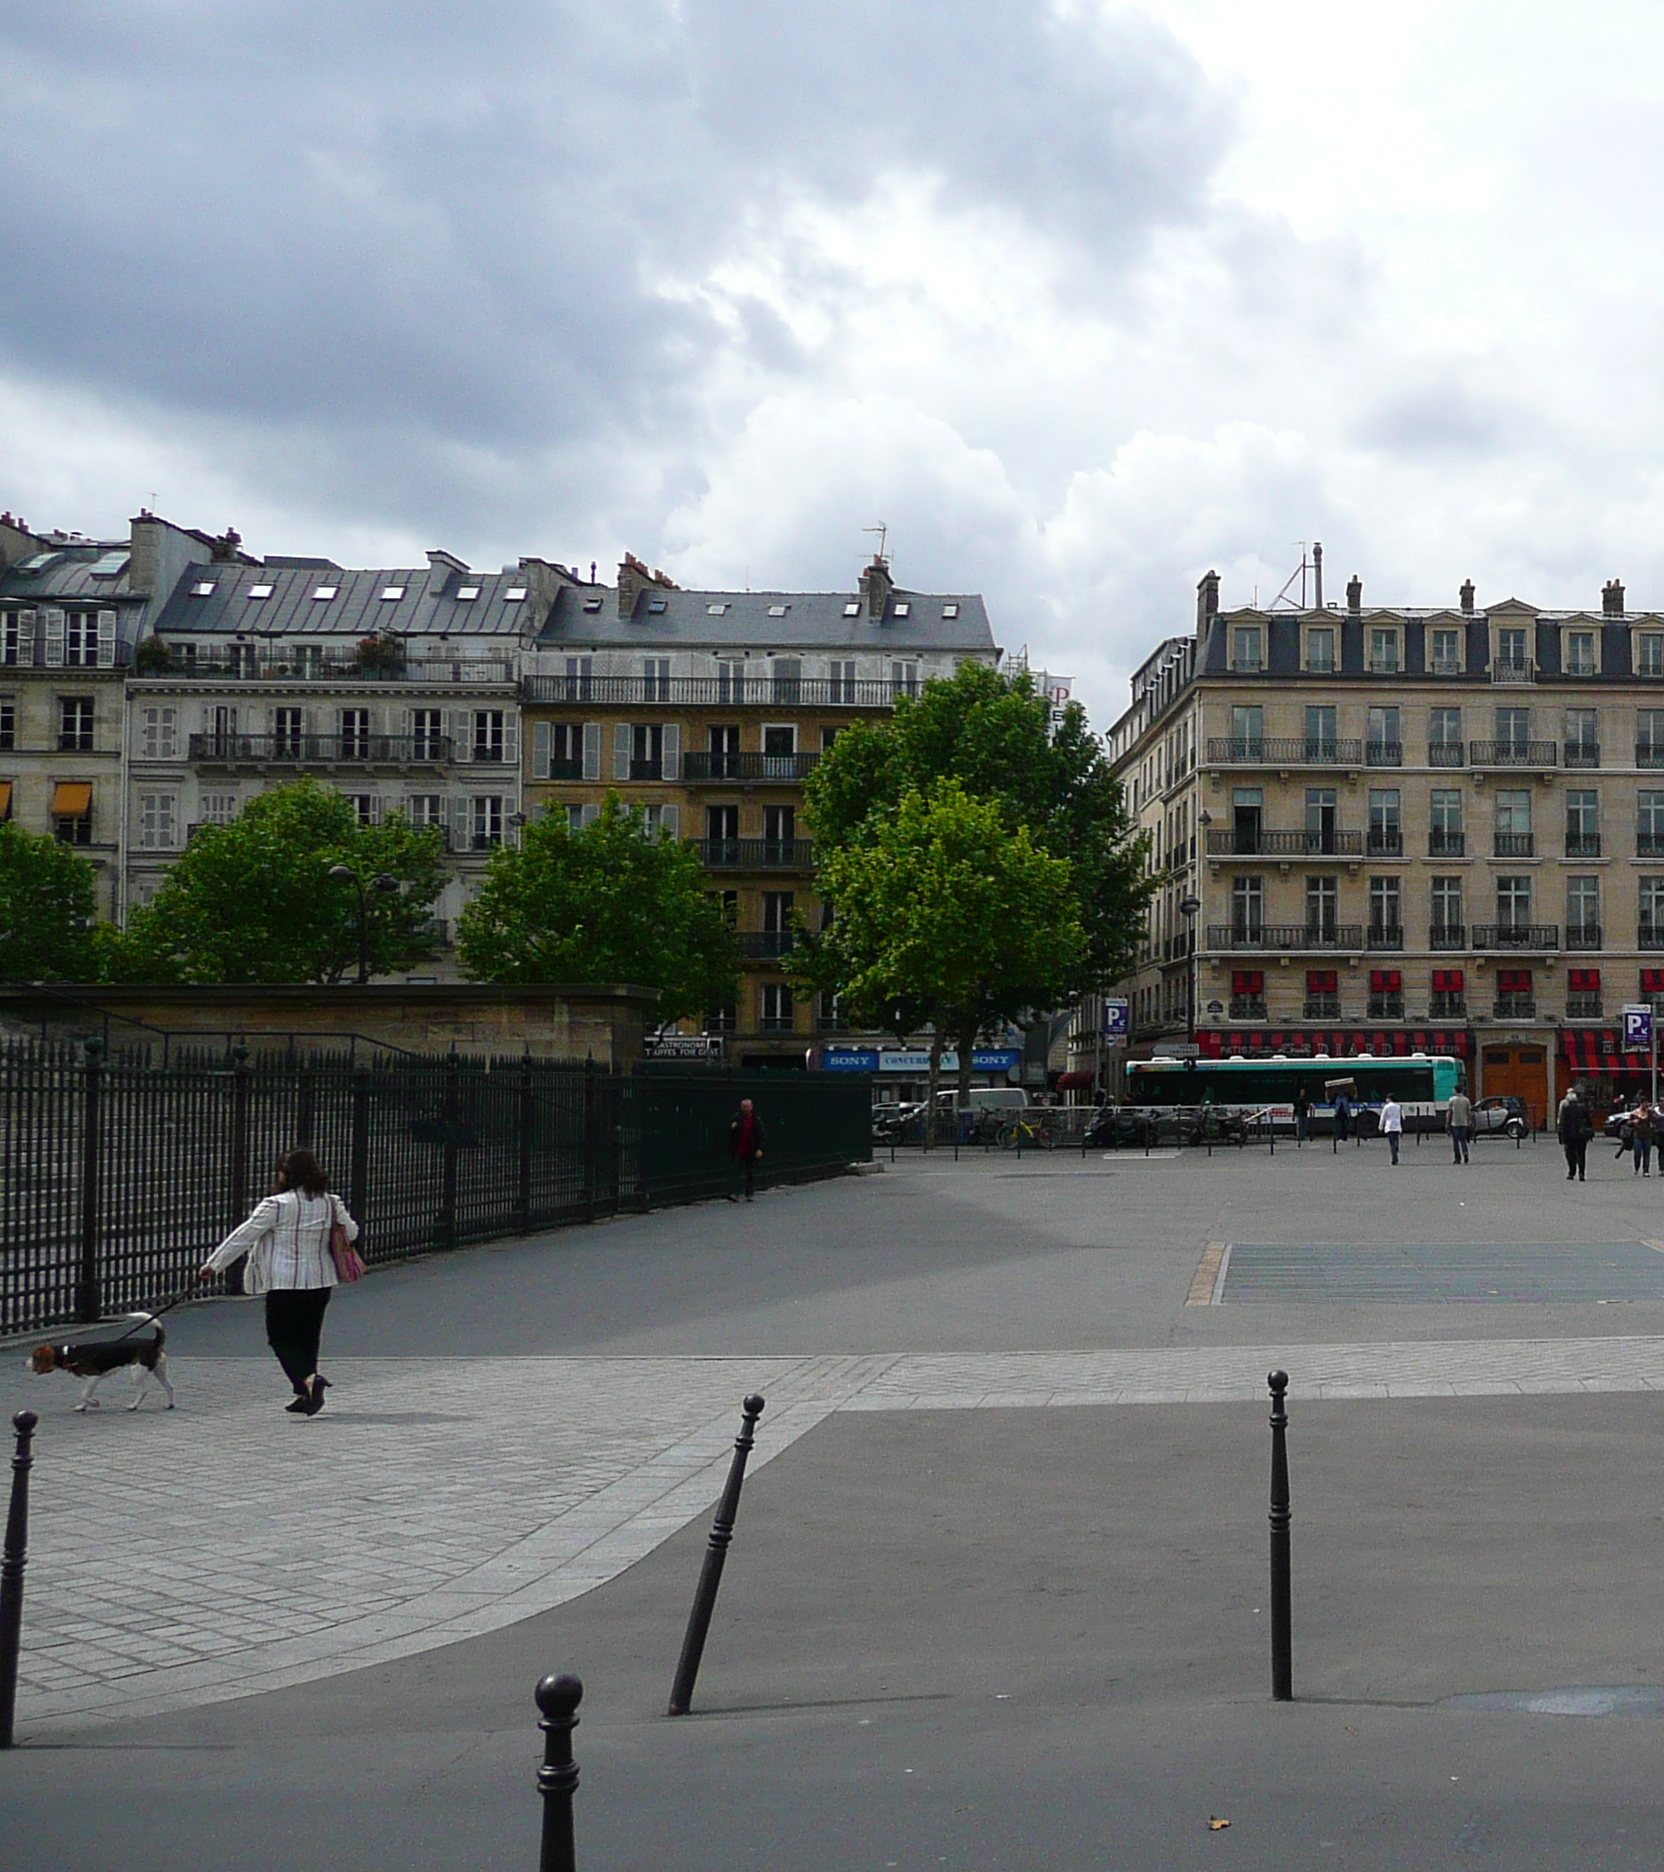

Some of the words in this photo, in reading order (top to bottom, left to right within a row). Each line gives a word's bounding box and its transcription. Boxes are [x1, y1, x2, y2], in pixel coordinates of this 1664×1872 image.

[1108, 1007, 1120, 1026] P
[1627, 1016, 1642, 1035] P
[830, 1056, 870, 1065] SONY
[972, 1055, 1009, 1065] SONY
